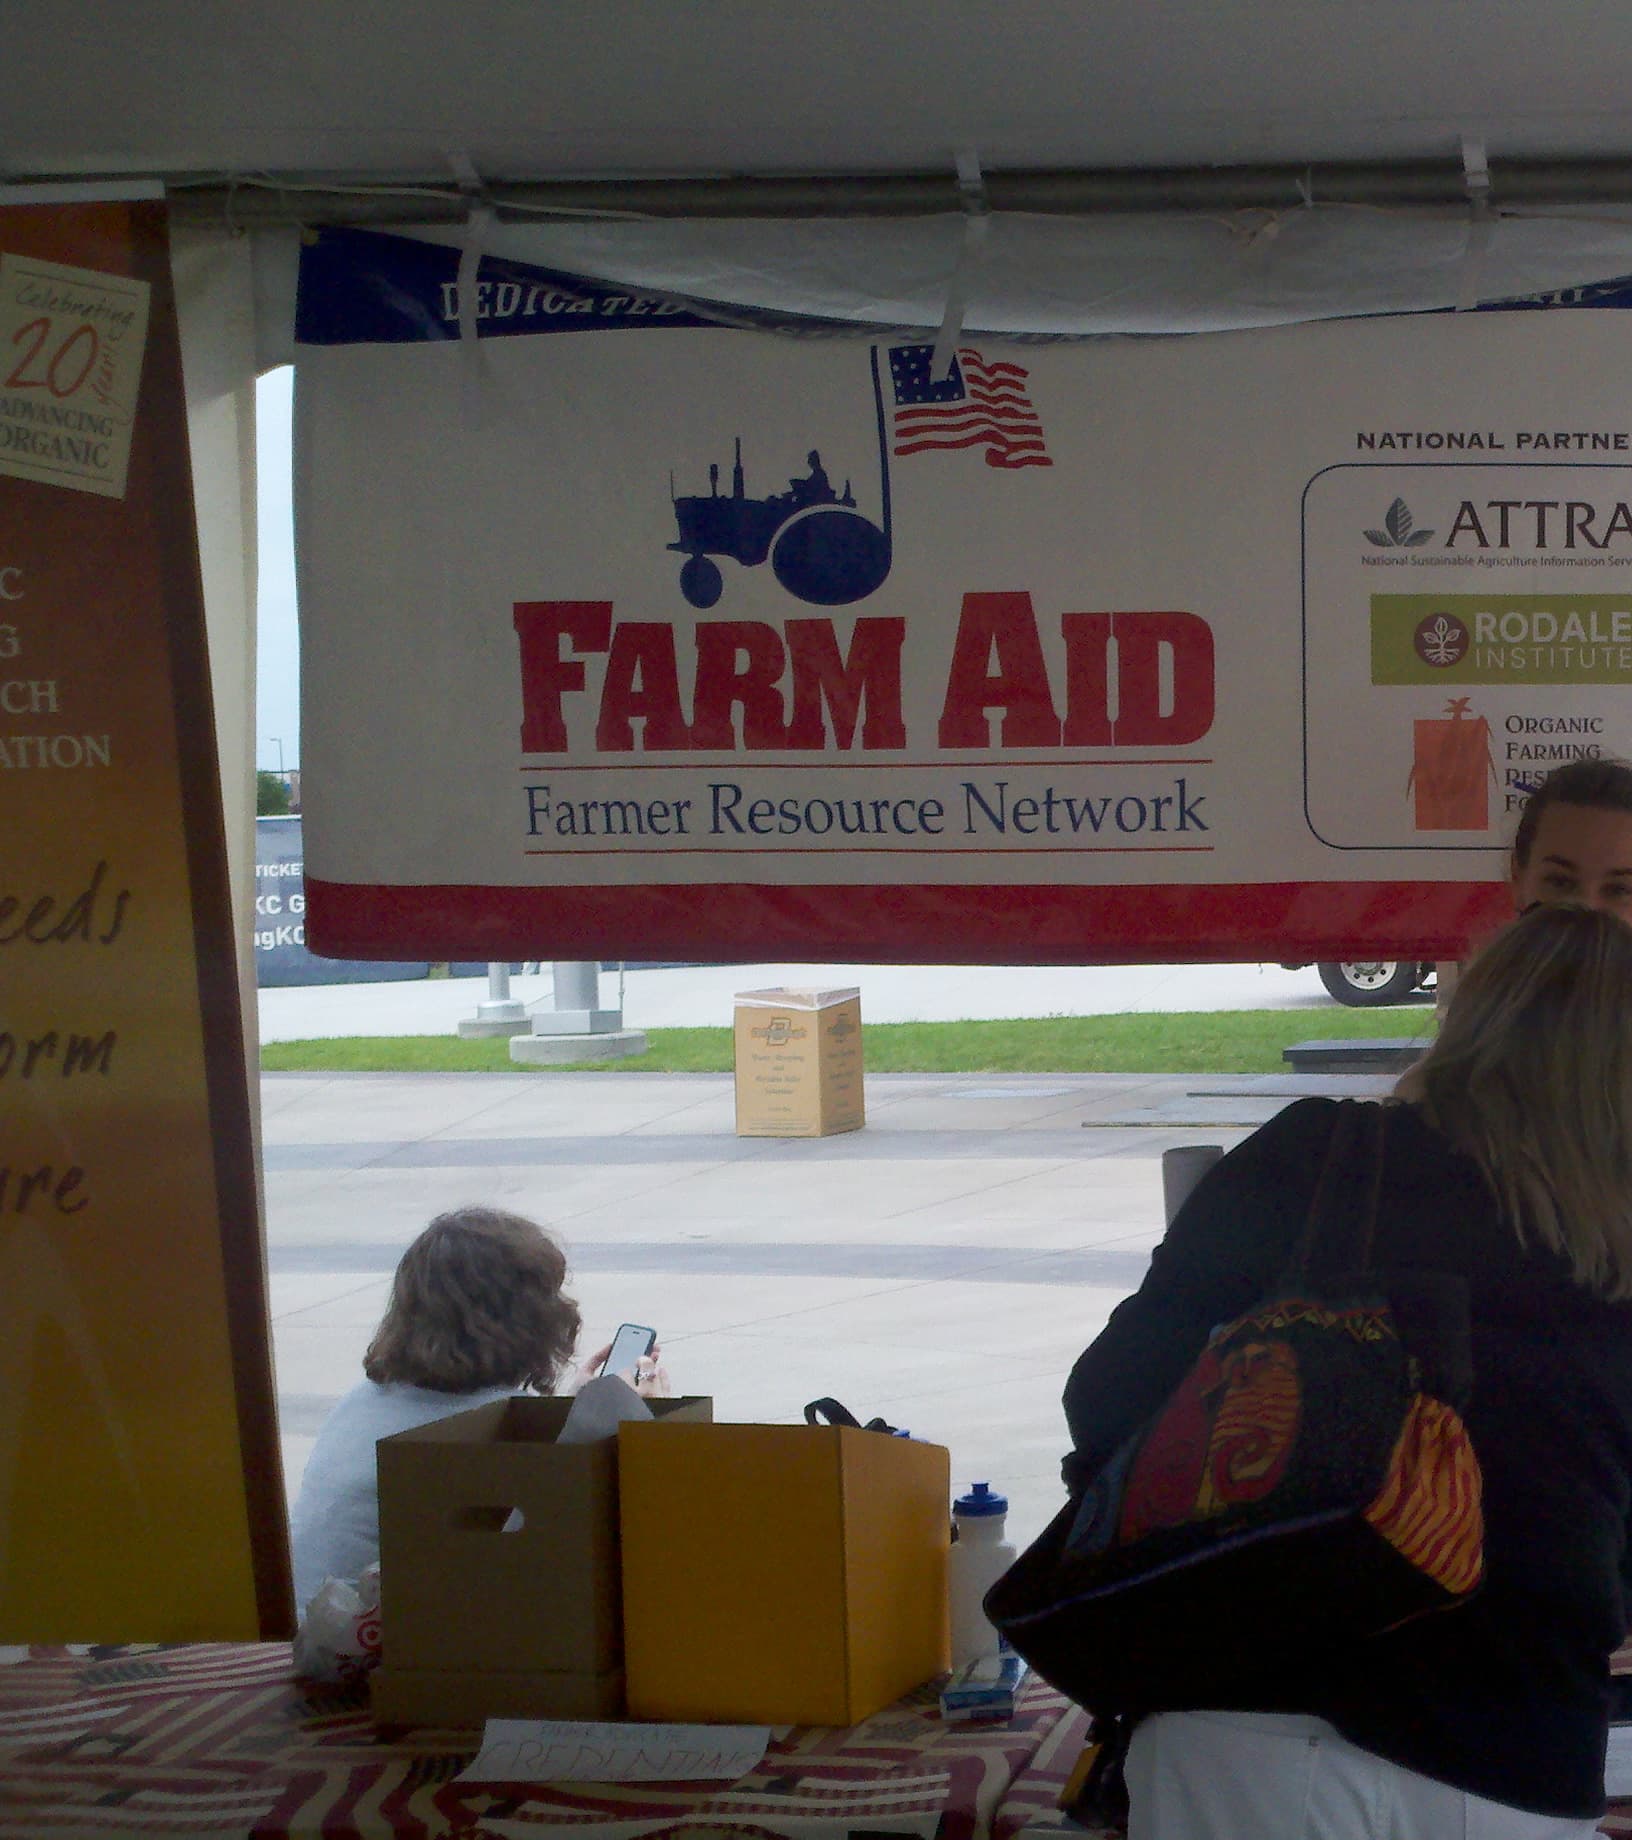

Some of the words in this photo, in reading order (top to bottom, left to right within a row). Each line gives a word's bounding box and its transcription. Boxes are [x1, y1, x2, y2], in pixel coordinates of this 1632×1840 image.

[3, 317, 99, 398] 20
[1356, 431, 1505, 450] NATIONAL
[1361, 554, 1408, 566] National
[1410, 554, 1475, 567] Sustainable
[1477, 555, 1538, 569] Agriculture
[1540, 555, 1605, 567] Information
[1475, 611, 1632, 644] RODALE
[1475, 646, 1632, 670] INSTITUTE
[513, 600, 907, 753] FARM
[938, 591, 1216, 749] AID
[1505, 714, 1603, 734] ORGANIC
[1505, 741, 1602, 761] FARMING
[522, 786, 692, 837] Farmer
[708, 783, 945, 835] Resource
[960, 779, 1210, 834] Network
[255, 862, 304, 877] TICKE
